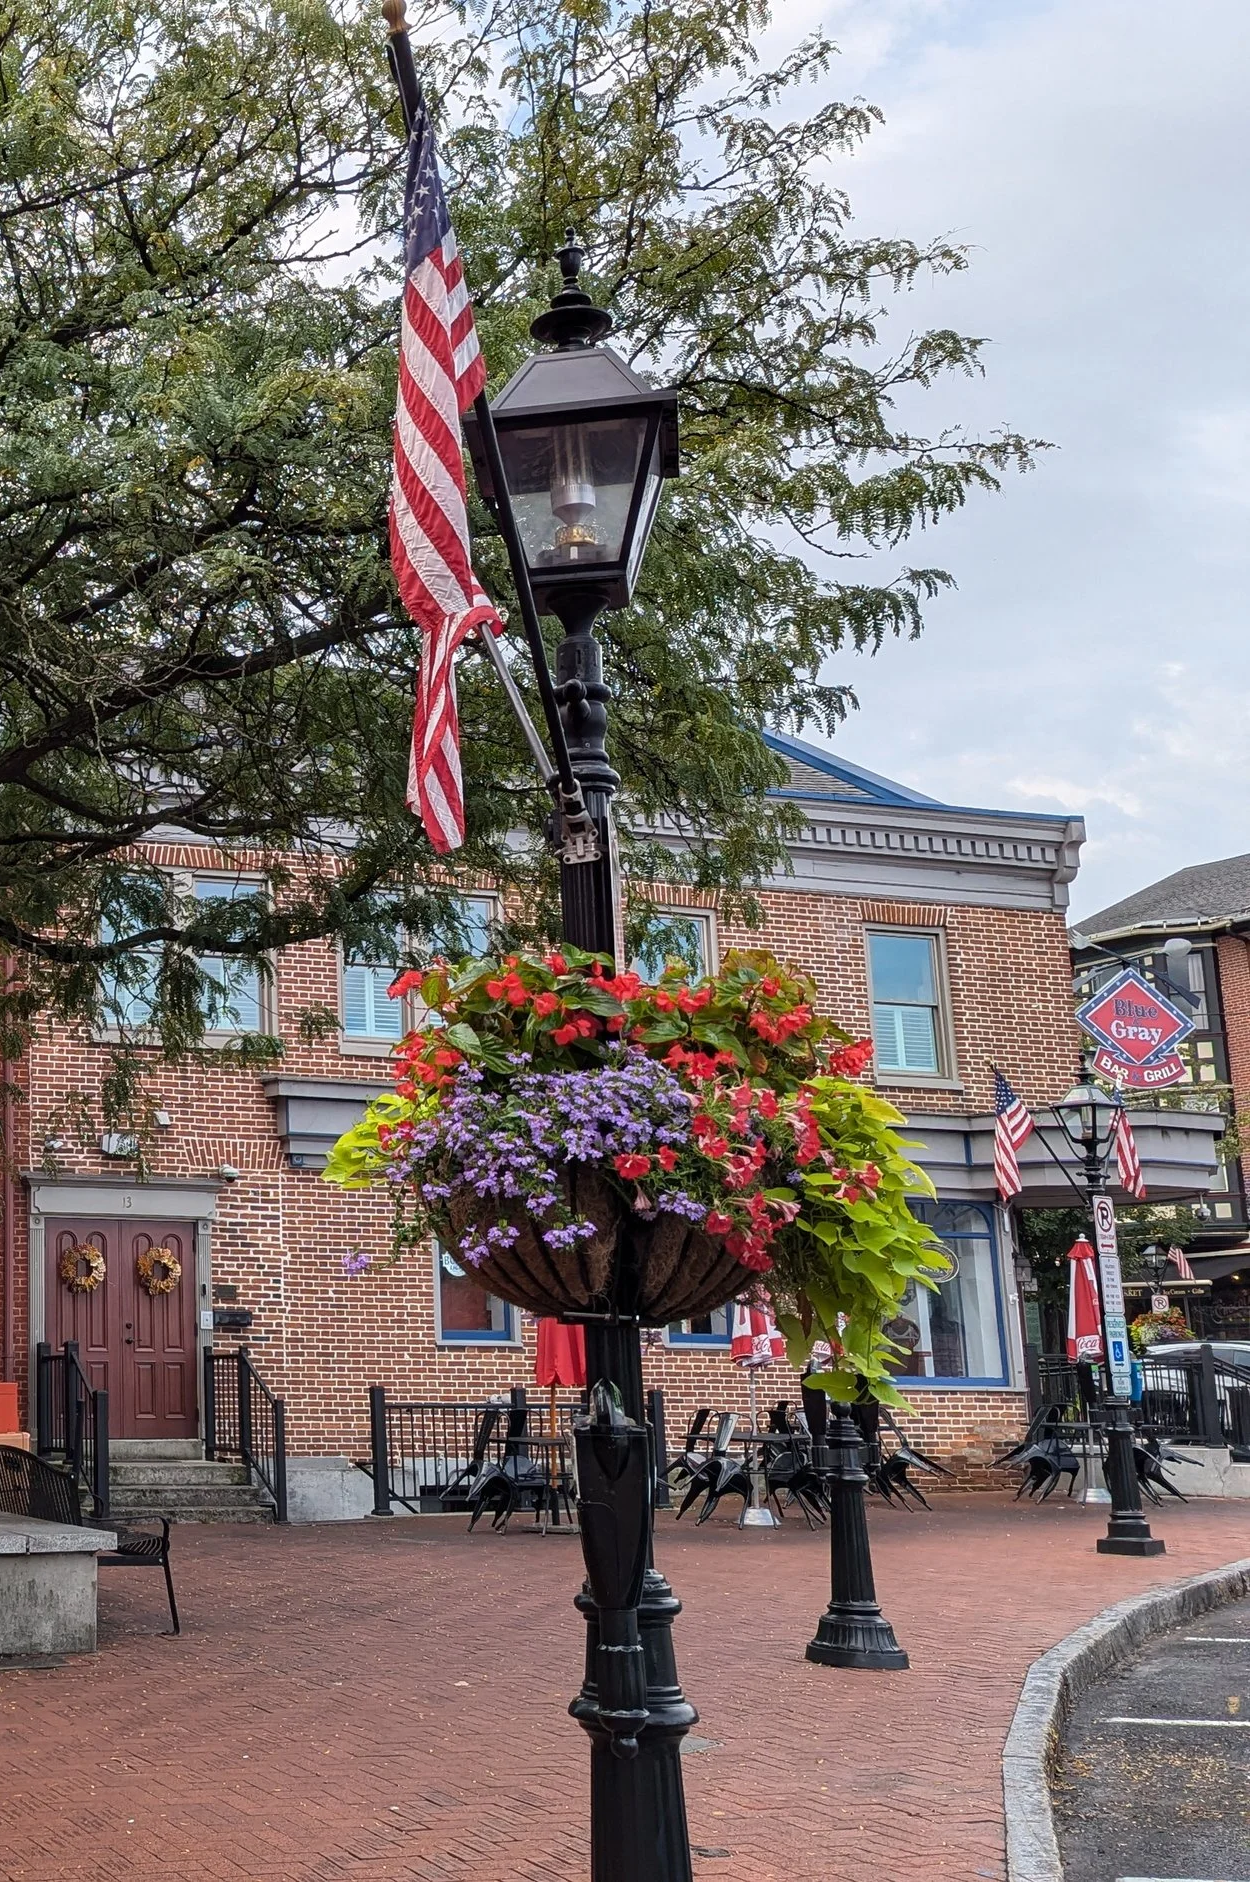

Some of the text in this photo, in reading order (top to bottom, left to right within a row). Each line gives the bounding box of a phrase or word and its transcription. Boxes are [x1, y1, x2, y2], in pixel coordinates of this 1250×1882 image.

[1114, 998, 1157, 1018] Blue
[1110, 1020, 1162, 1045] Gray
[1100, 1055, 1129, 1080] BAR
[1144, 1062, 1181, 1082] GRILL
[122, 1196, 132, 1208] 13
